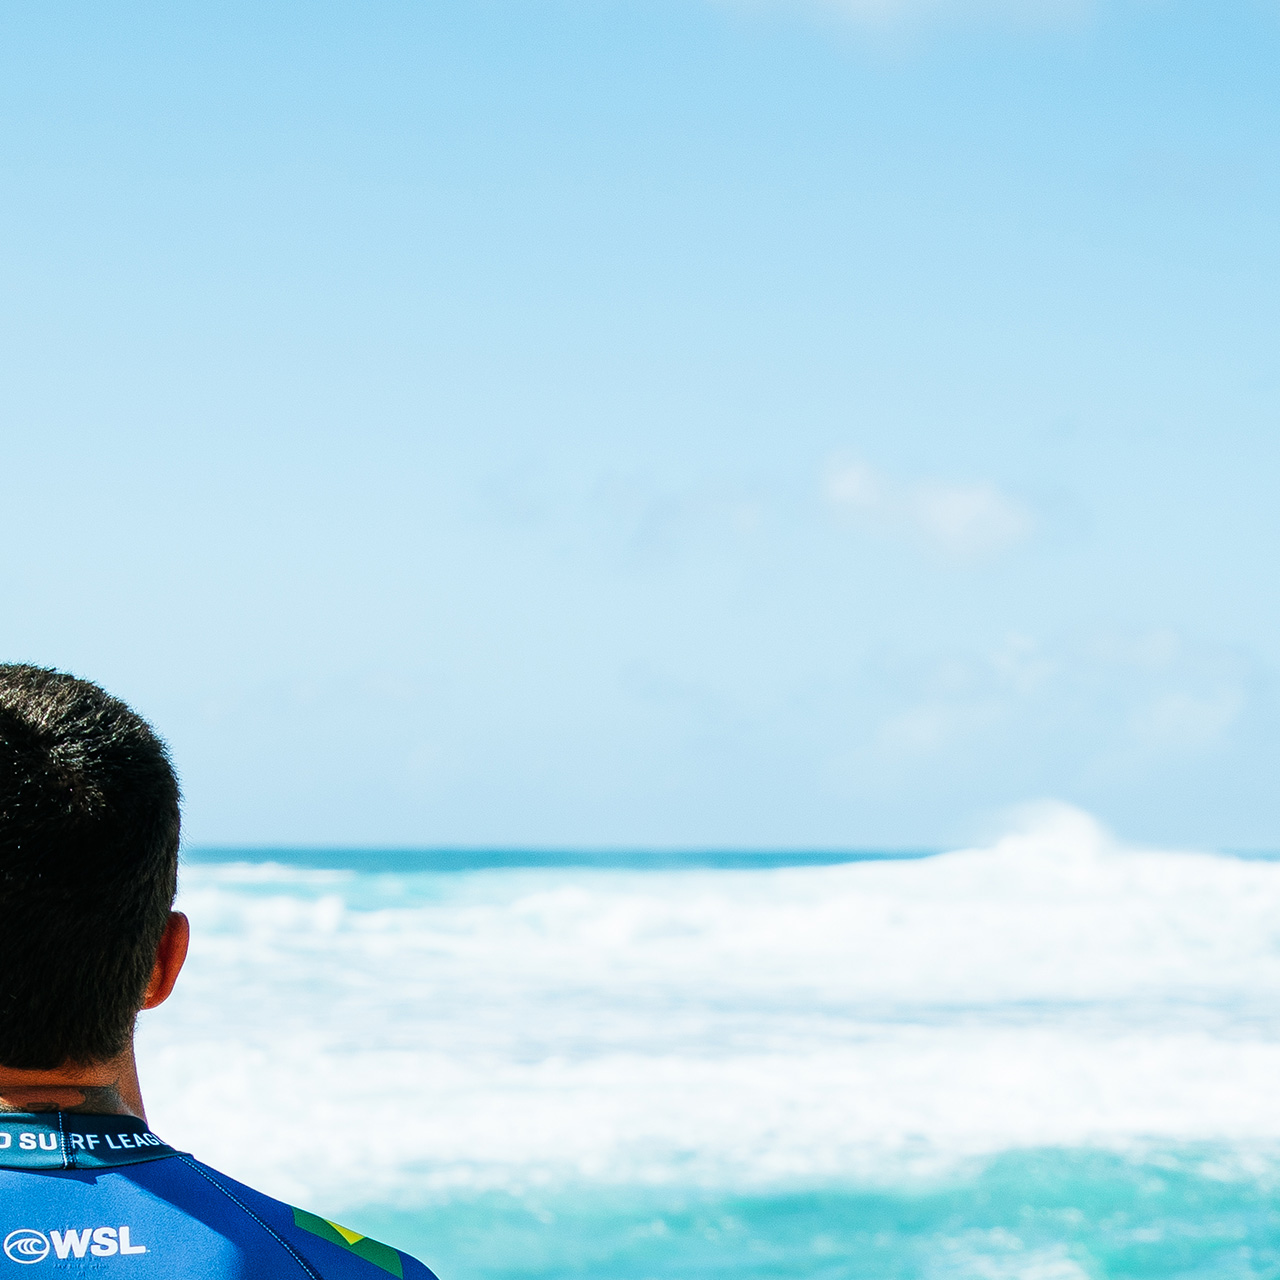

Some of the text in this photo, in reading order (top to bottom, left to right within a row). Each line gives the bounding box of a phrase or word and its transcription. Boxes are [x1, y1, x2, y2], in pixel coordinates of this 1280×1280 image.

[19, 1132, 102, 1151] SURF
[105, 1132, 167, 1150] LEAG
[49, 1225, 147, 1260] WSL
